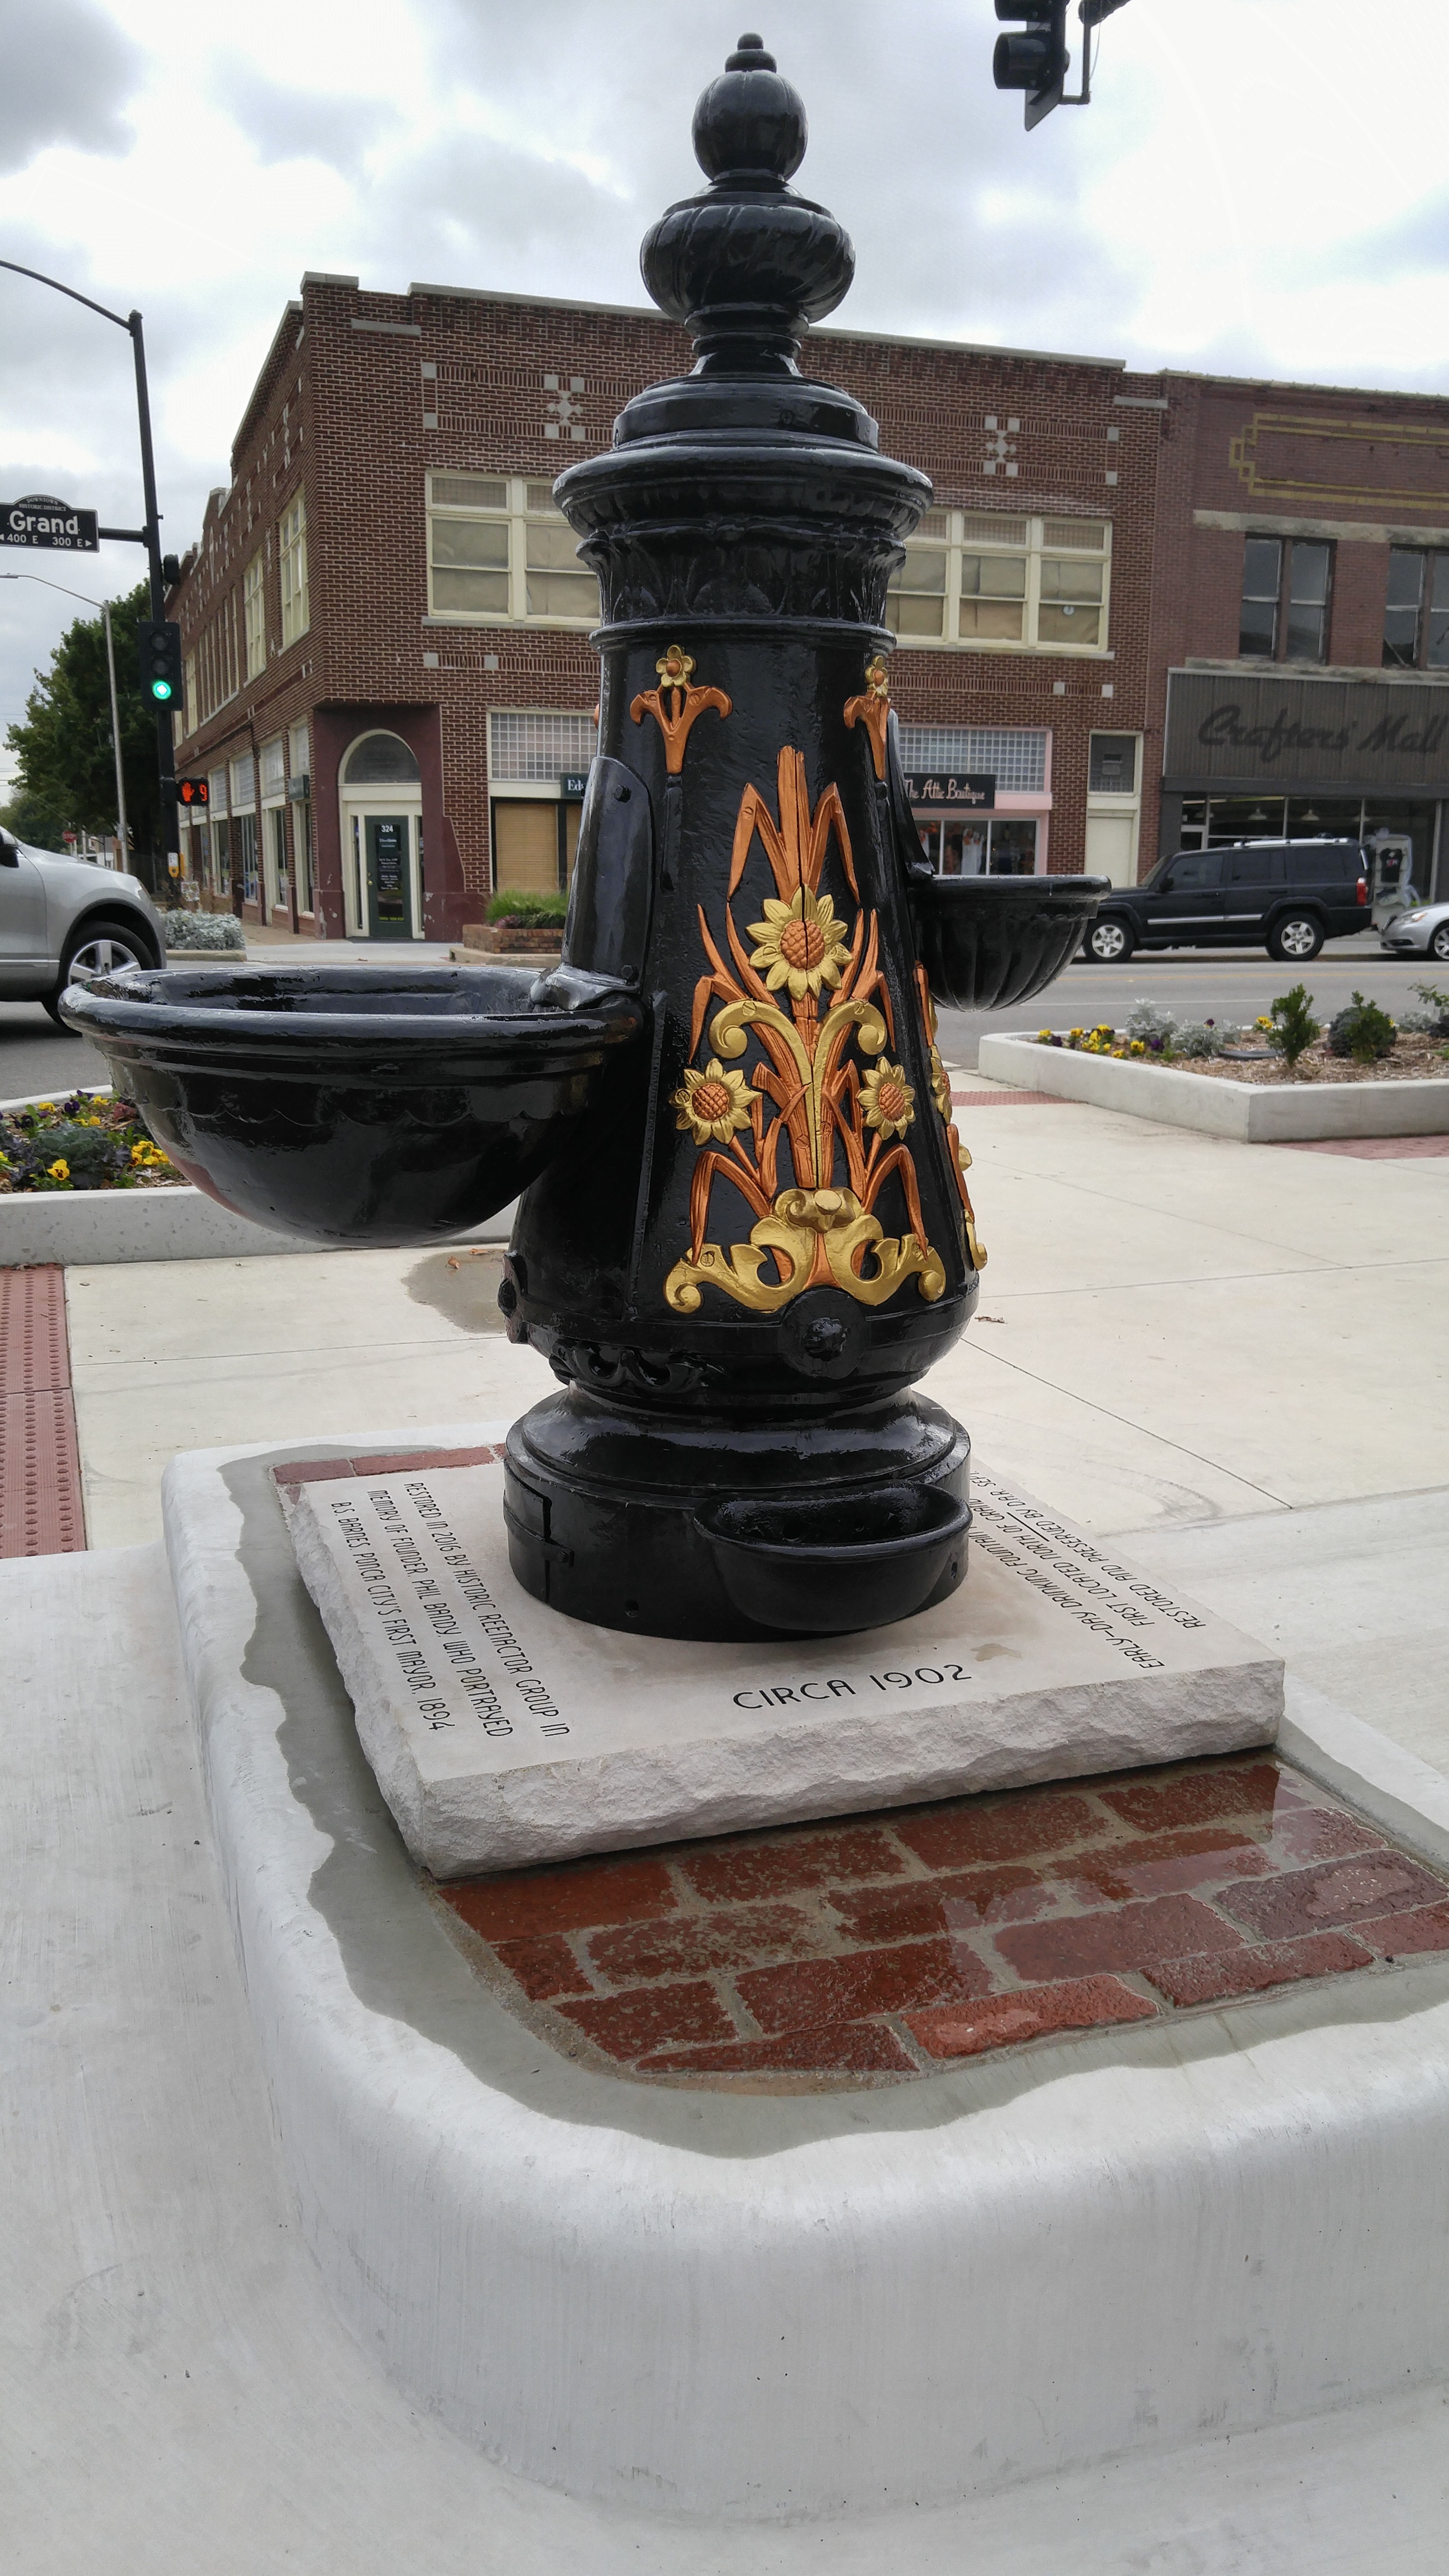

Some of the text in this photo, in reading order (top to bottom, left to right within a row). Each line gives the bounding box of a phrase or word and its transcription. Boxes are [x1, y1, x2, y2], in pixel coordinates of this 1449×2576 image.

[26, 497, 58, 505] DOWNTOWN
[9, 510, 79, 535] Grand
[7, 533, 83, 547] 400 E 300 E
[1198, 705, 1448, 762] Crafters' Mall
[199, 783, 208, 801] 9
[904, 778, 985, 805] The Attic Boutique
[331, 1502, 355, 1516] B.S.
[367, 1490, 402, 1521] MEMORY
[990, 1488, 1026, 1506] D.A.R.
[1015, 1509, 1044, 1518] BY
[384, 1524, 408, 1533] OF
[1036, 1521, 1109, 1562] PRESERVED
[1012, 1535, 1062, 1559] NORTH
[353, 1552, 386, 1582] PONCA
[1101, 1564, 1137, 1581] AND
[412, 1579, 441, 1600] PHIL
[1053, 1562, 1117, 1599] LOCATED
[368, 1585, 402, 1615] CITY'S
[404, 1482, 570, 1737] RESTORED IN 2016 BY HISTORIC REENACTOR GROUP IN
[968, 1531, 1165, 1668] EARLY-DAY DRINKING FOUNTAIN
[1129, 1584, 1206, 1628] RESTORED
[1106, 1603, 1155, 1626] FIRST
[382, 1619, 417, 1645] FIRST
[443, 1641, 476, 1664] WHO
[733, 1664, 972, 1709] CIRCA 1902
[417, 1698, 455, 1730] 1894
[456, 1668, 513, 1737] PORTRAYED
